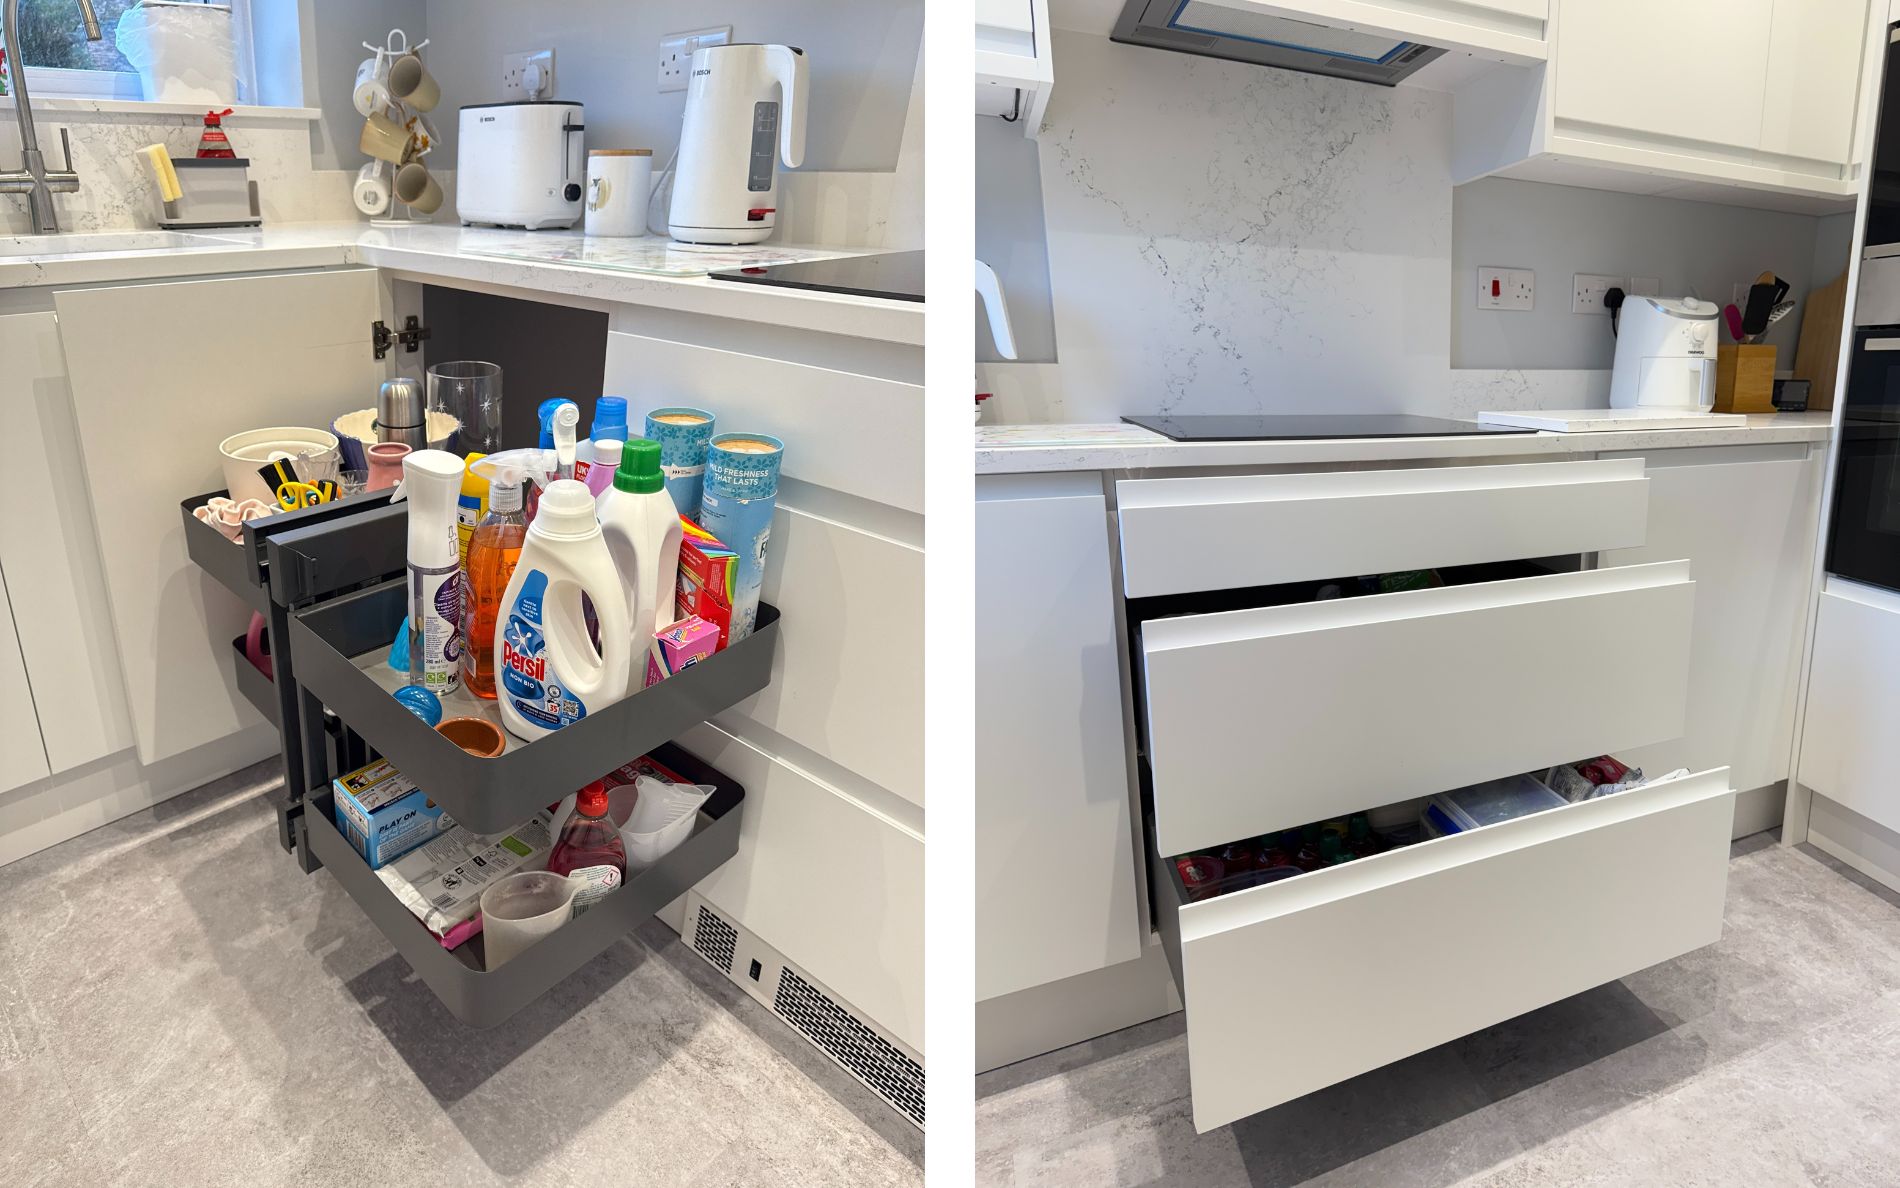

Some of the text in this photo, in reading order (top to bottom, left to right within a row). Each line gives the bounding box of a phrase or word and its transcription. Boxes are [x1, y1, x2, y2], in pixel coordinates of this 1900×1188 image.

[709, 463, 769, 478] MILD FRESHNESS
[714, 473, 758, 486] THAT LASTS
[503, 639, 546, 682] Persil
[509, 672, 535, 689] NON BIO
[549, 704, 558, 713] 35
[378, 809, 417, 834] PLAY ON
